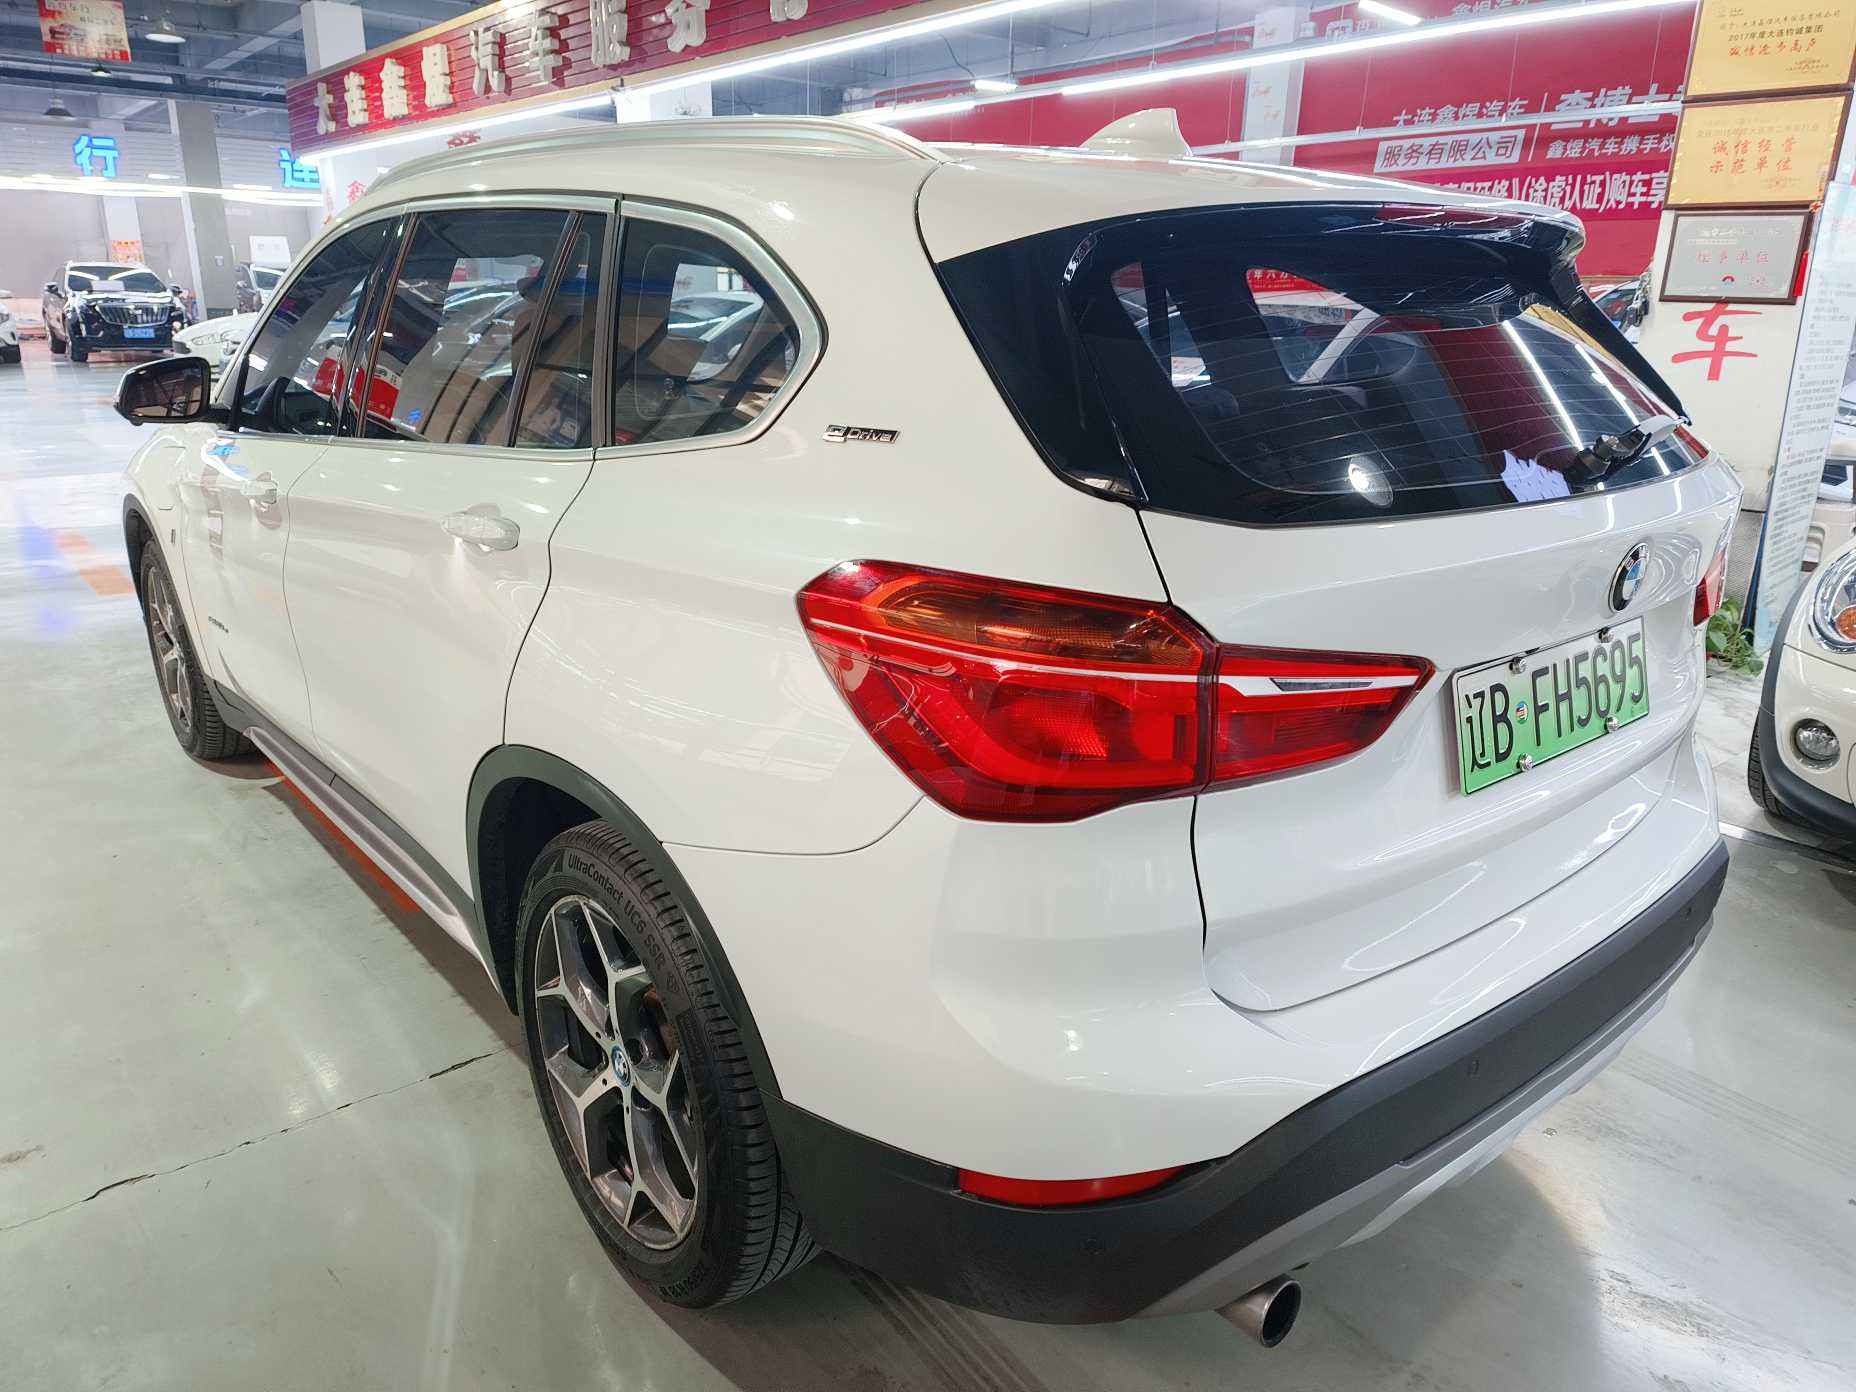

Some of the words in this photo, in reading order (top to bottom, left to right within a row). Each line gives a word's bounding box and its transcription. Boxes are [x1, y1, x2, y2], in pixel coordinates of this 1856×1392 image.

[1393, 97, 1529, 128] 大连鑫煜汽车
[73, 134, 119, 177] 行
[1380, 134, 1518, 169] 服务有限公司
[1709, 155, 1793, 175] 示范单位
[1671, 302, 1763, 381] 车
[1465, 682, 1514, 773] 辽B
[1531, 632, 1645, 747] FH5695
[568, 854, 624, 904] UltraContact
